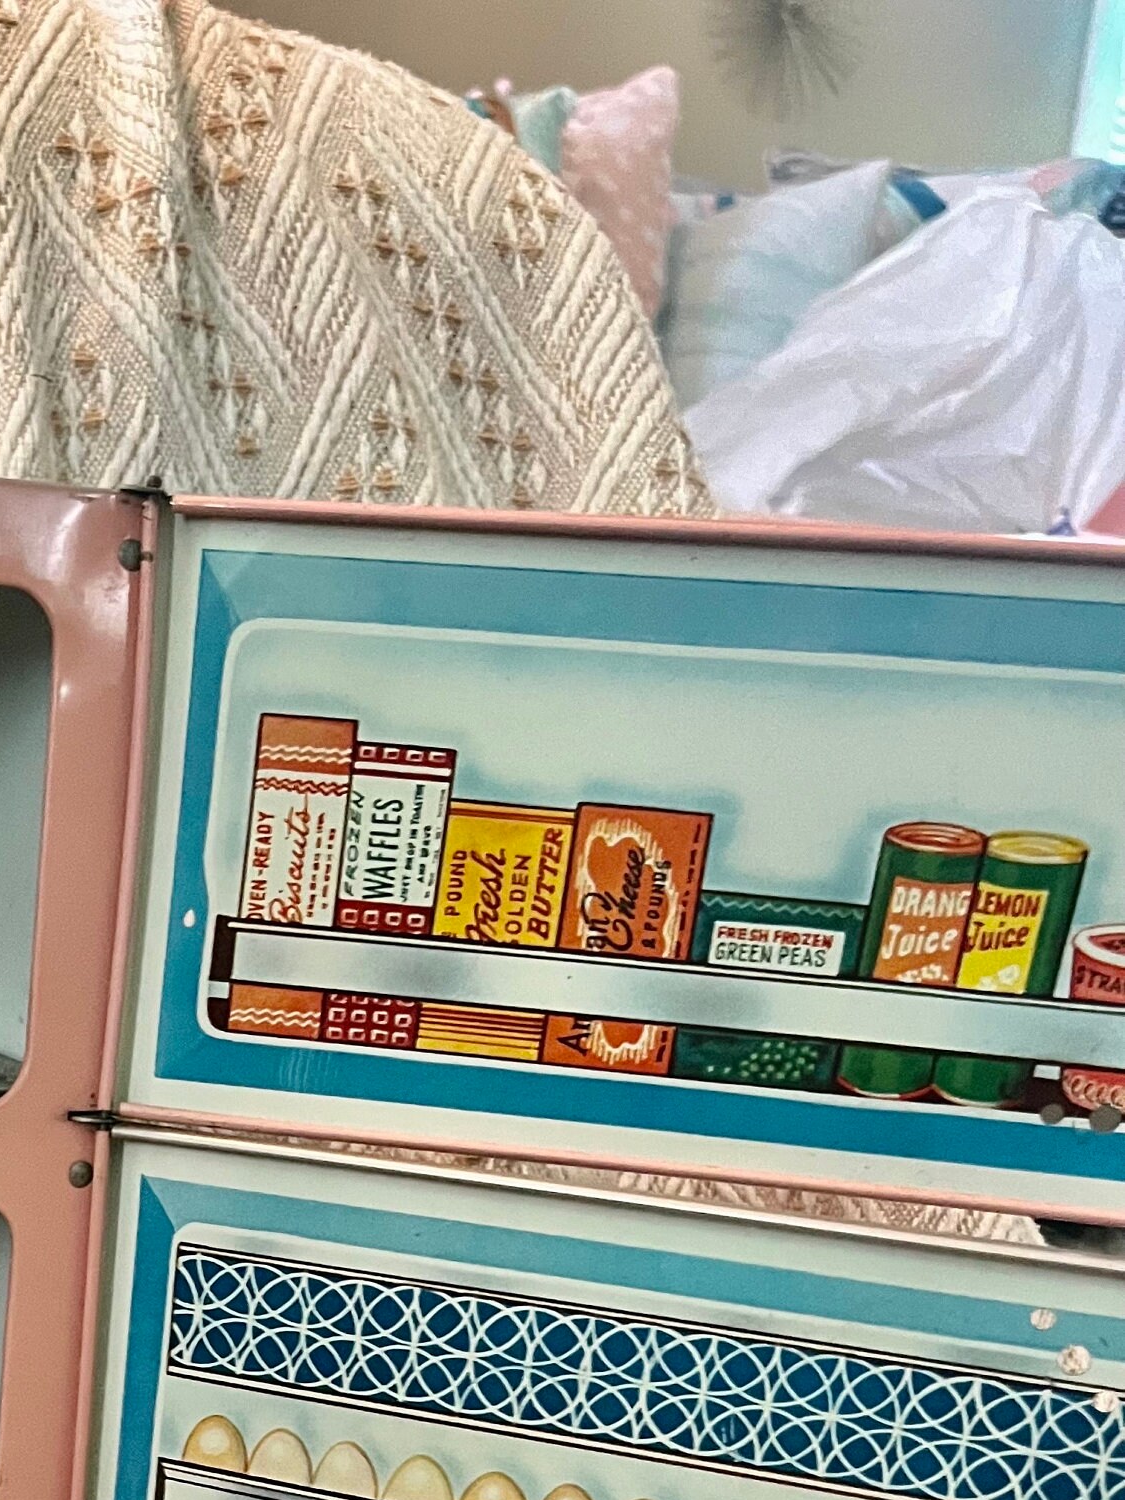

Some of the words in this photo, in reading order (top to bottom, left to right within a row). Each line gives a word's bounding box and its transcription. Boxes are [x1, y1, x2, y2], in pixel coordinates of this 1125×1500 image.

[344, 790, 365, 896] FROZEN
[362, 799, 404, 899] WAFFLES
[443, 849, 467, 916] POUND
[505, 855, 532, 944] OLDEN
[527, 828, 563, 940] BUTTER
[605, 848, 645, 950] Cheese
[644, 860, 671, 932] POUNDS
[715, 942, 773, 964] GREEN
[778, 946, 827, 967] PEAS
[718, 926, 769, 942] FRESH
[773, 930, 835, 949] FROZEN
[881, 924, 958, 960] Juice
[964, 921, 1030, 953] Juice
